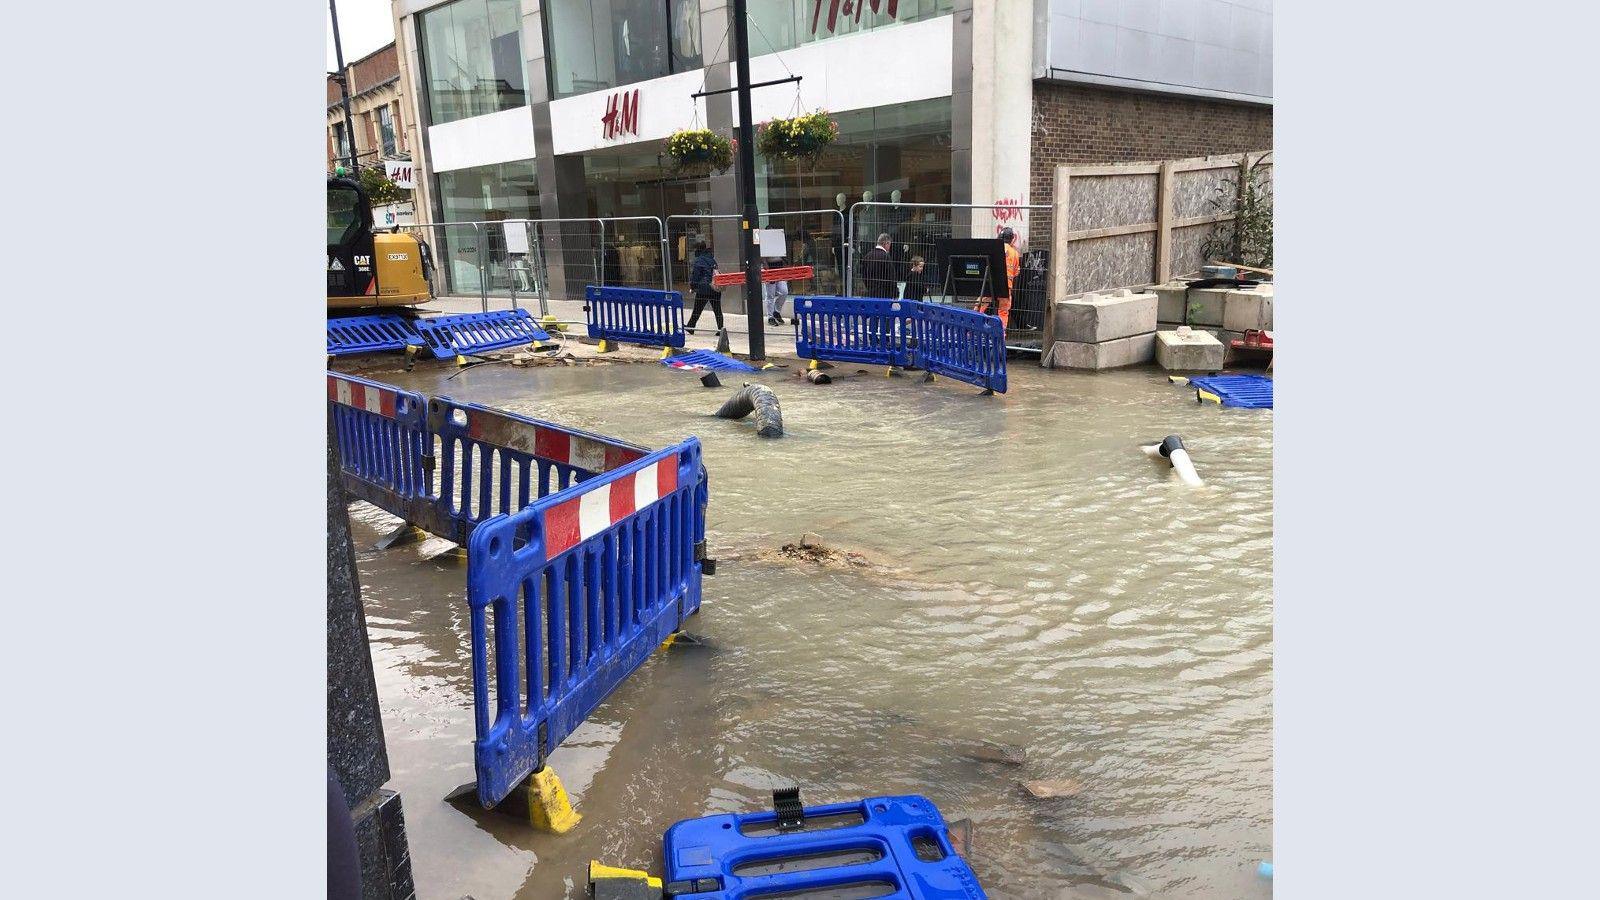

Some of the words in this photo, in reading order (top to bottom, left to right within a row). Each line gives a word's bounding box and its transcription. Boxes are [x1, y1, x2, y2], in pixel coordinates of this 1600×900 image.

[601, 88, 639, 139] H&M
[390, 166, 412, 182] H&M
[354, 255, 371, 266] CAT
